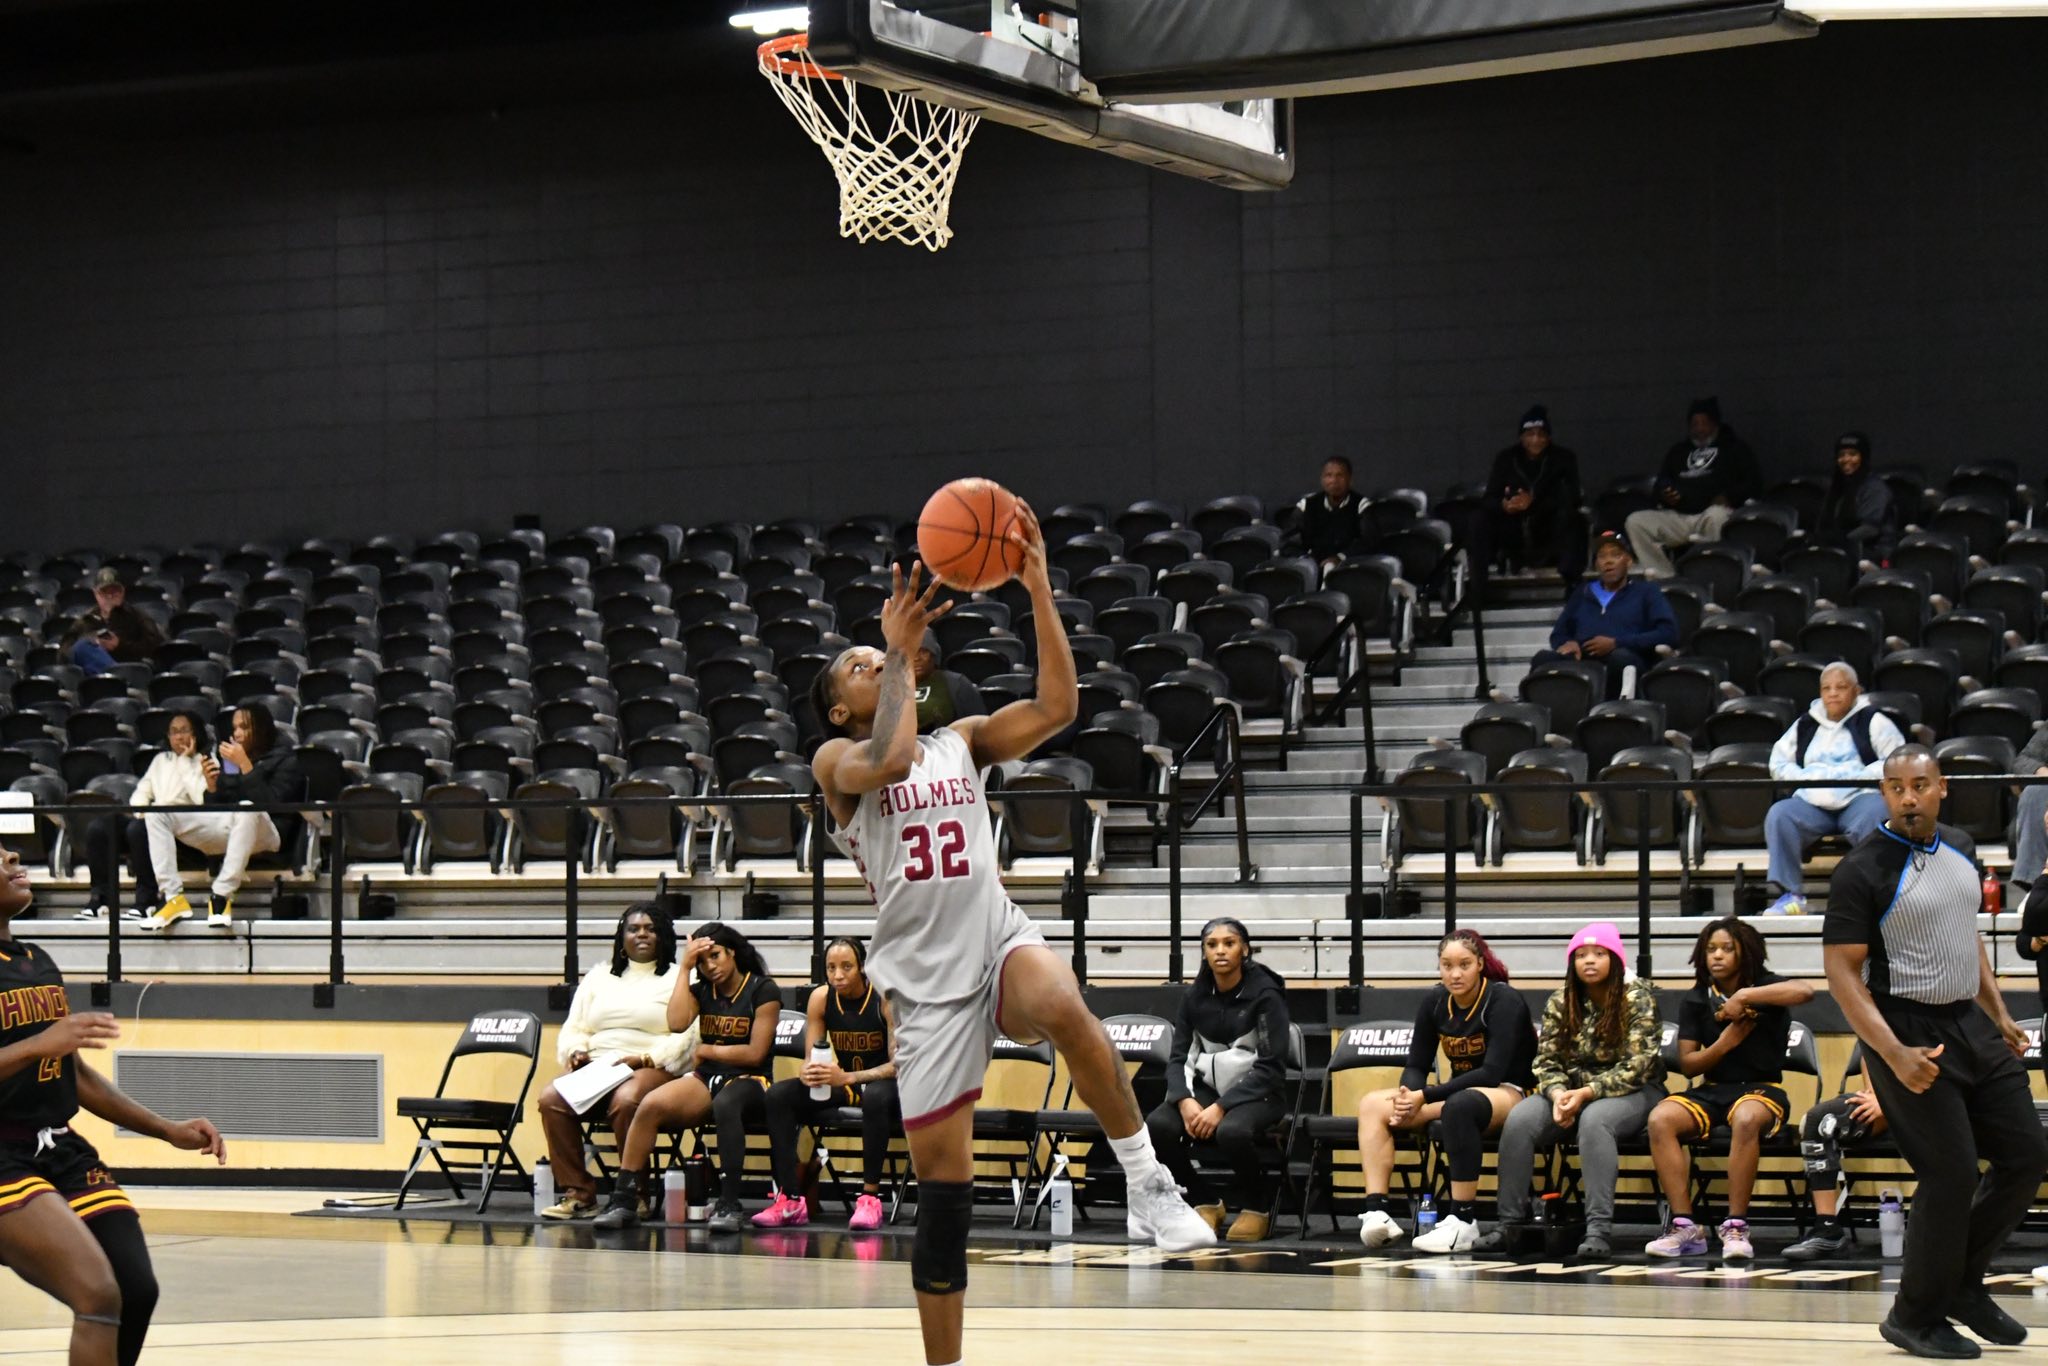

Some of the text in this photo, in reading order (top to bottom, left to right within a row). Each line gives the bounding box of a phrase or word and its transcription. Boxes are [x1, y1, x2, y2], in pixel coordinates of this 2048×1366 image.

[879, 777, 976, 818] HOLMES
[900, 818, 971, 883] 32
[0, 984, 71, 1030] HIND
[469, 1017, 530, 1034] HOLMES
[475, 1033, 517, 1043] BASKETBALL
[1357, 1046, 1411, 1056] BASKETBALL
